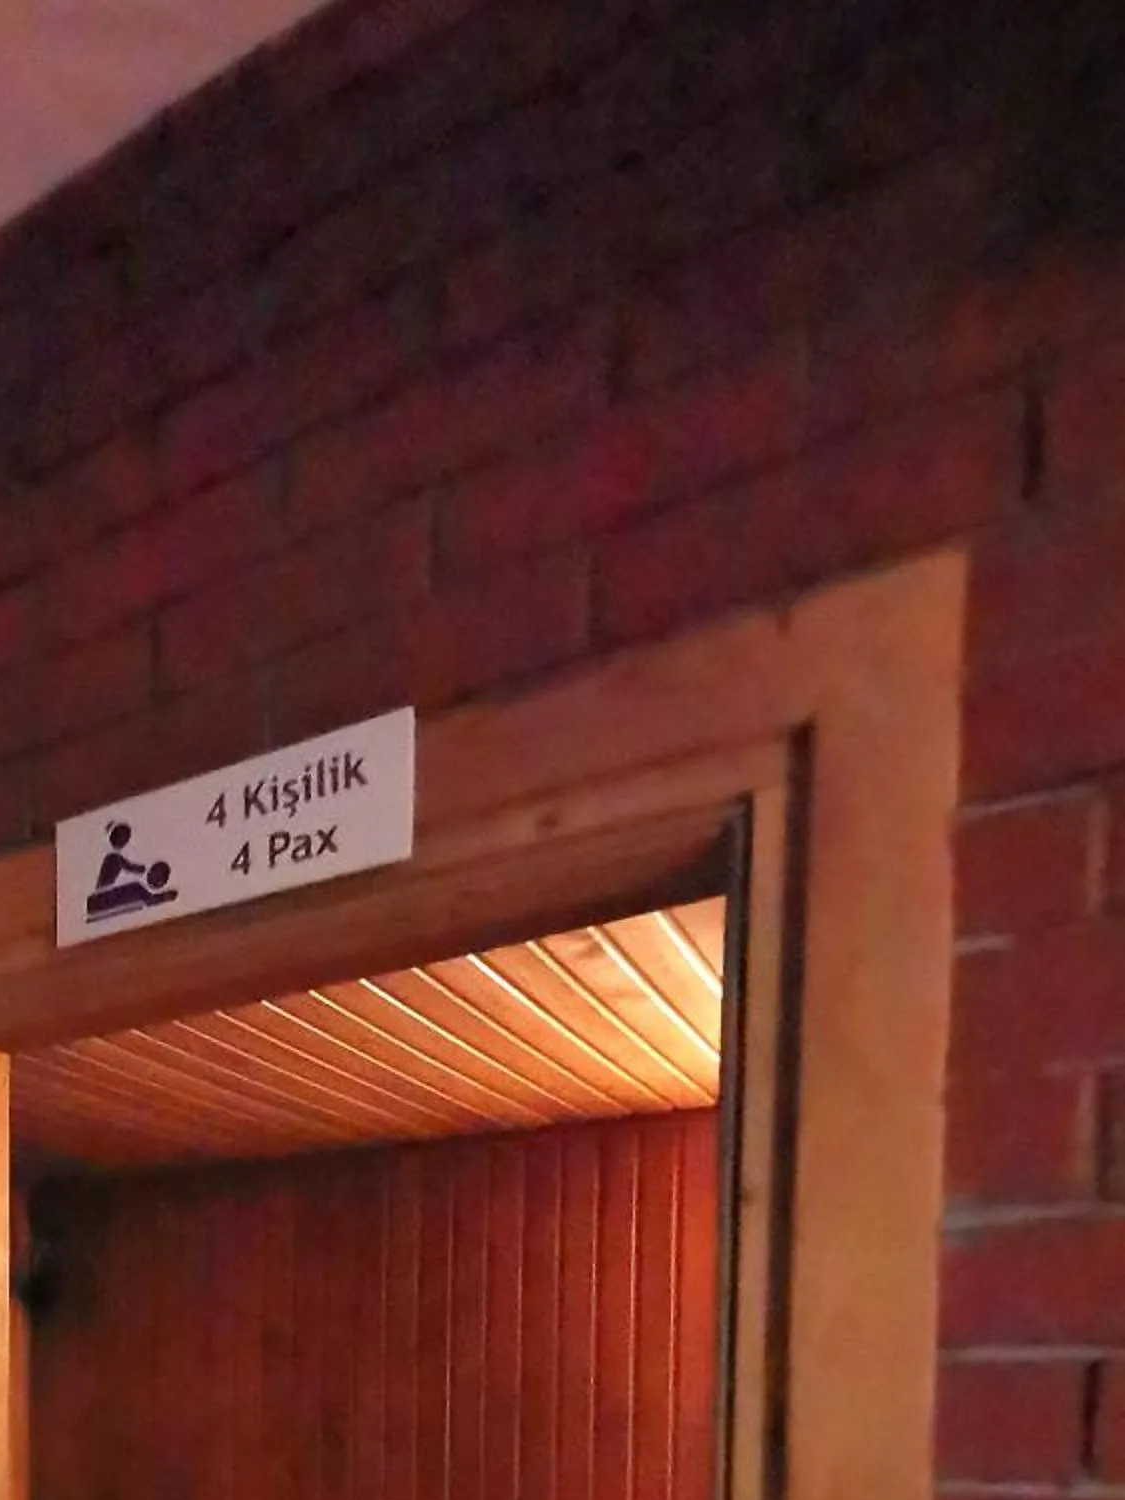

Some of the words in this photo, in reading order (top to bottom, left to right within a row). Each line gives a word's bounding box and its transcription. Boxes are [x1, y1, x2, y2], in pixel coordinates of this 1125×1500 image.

[205, 791, 228, 829] 4
[242, 751, 369, 819] Kişilik
[229, 840, 253, 876] 4
[266, 824, 339, 870] Pax
